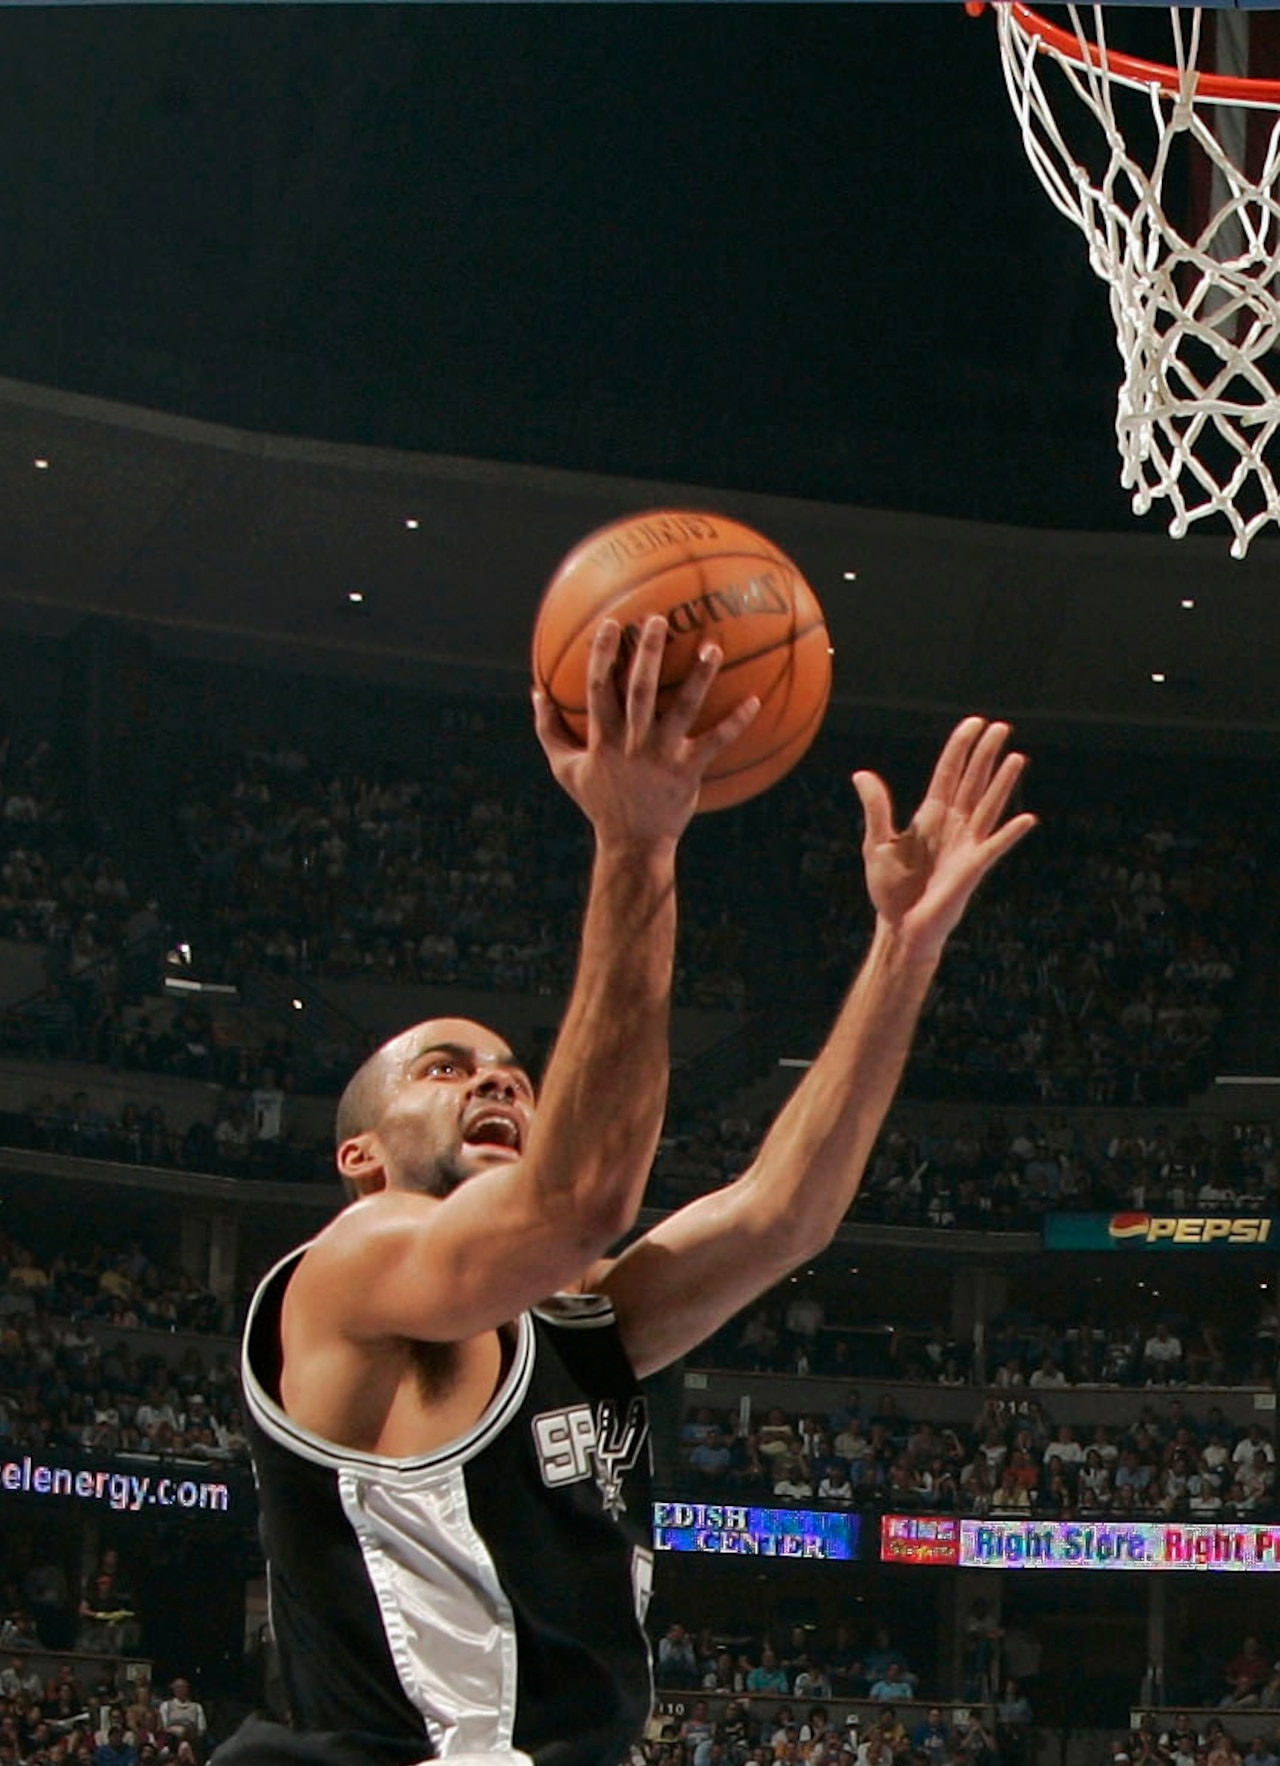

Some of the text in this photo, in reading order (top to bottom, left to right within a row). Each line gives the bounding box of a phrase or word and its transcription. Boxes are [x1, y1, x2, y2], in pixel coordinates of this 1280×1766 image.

[1147, 1218, 1271, 1242] PEPSI
[653, 1502, 749, 1532] EDISH
[1164, 1530, 1244, 1565] Right
